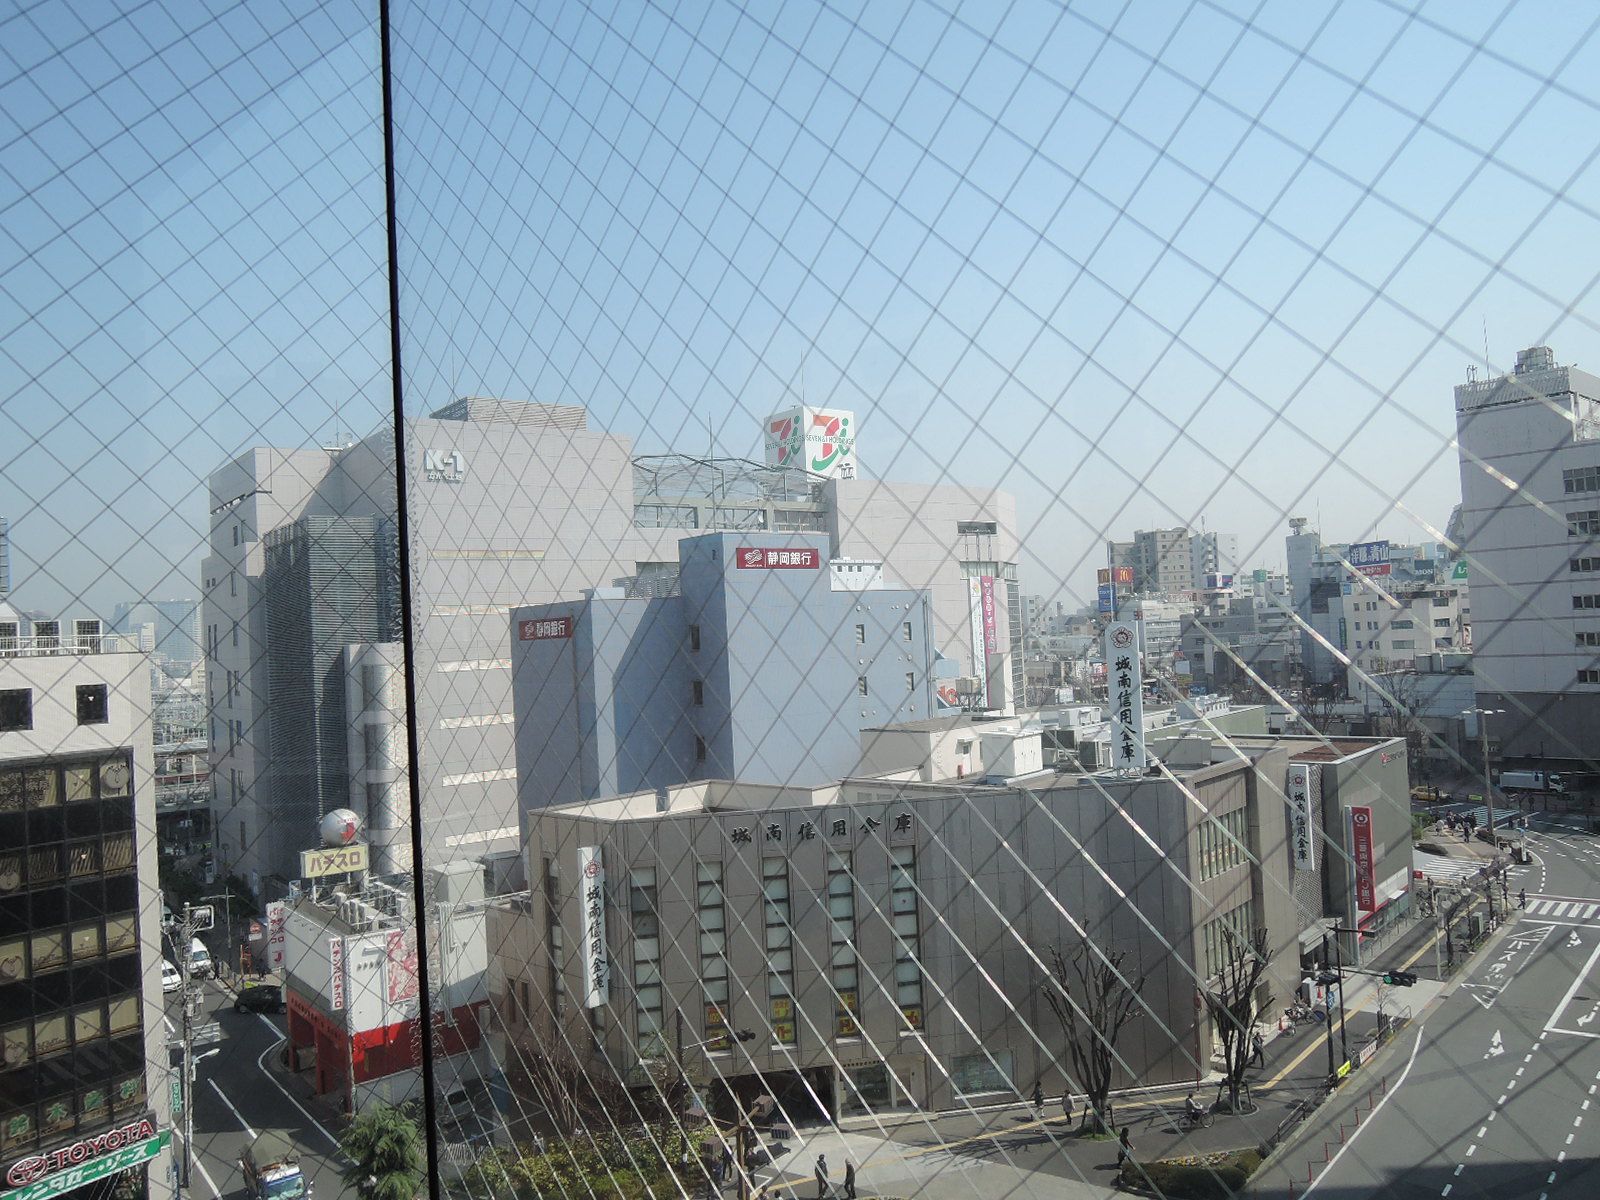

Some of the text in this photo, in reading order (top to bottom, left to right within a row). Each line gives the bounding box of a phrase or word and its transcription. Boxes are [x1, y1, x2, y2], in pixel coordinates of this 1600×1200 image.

[425, 449, 464, 471] K-1
[767, 551, 812, 566] 静岡銀行
[536, 620, 565, 638] 静岡銀行
[1115, 656, 1136, 763] 城南信用金庫
[731, 812, 911, 844] 城南信用金庫
[1295, 792, 1309, 861] 城南信用金庫
[310, 851, 361, 873] パチスロ
[586, 884, 606, 991] 城南信用金庫
[55, 1118, 153, 1169] TOYOTA
